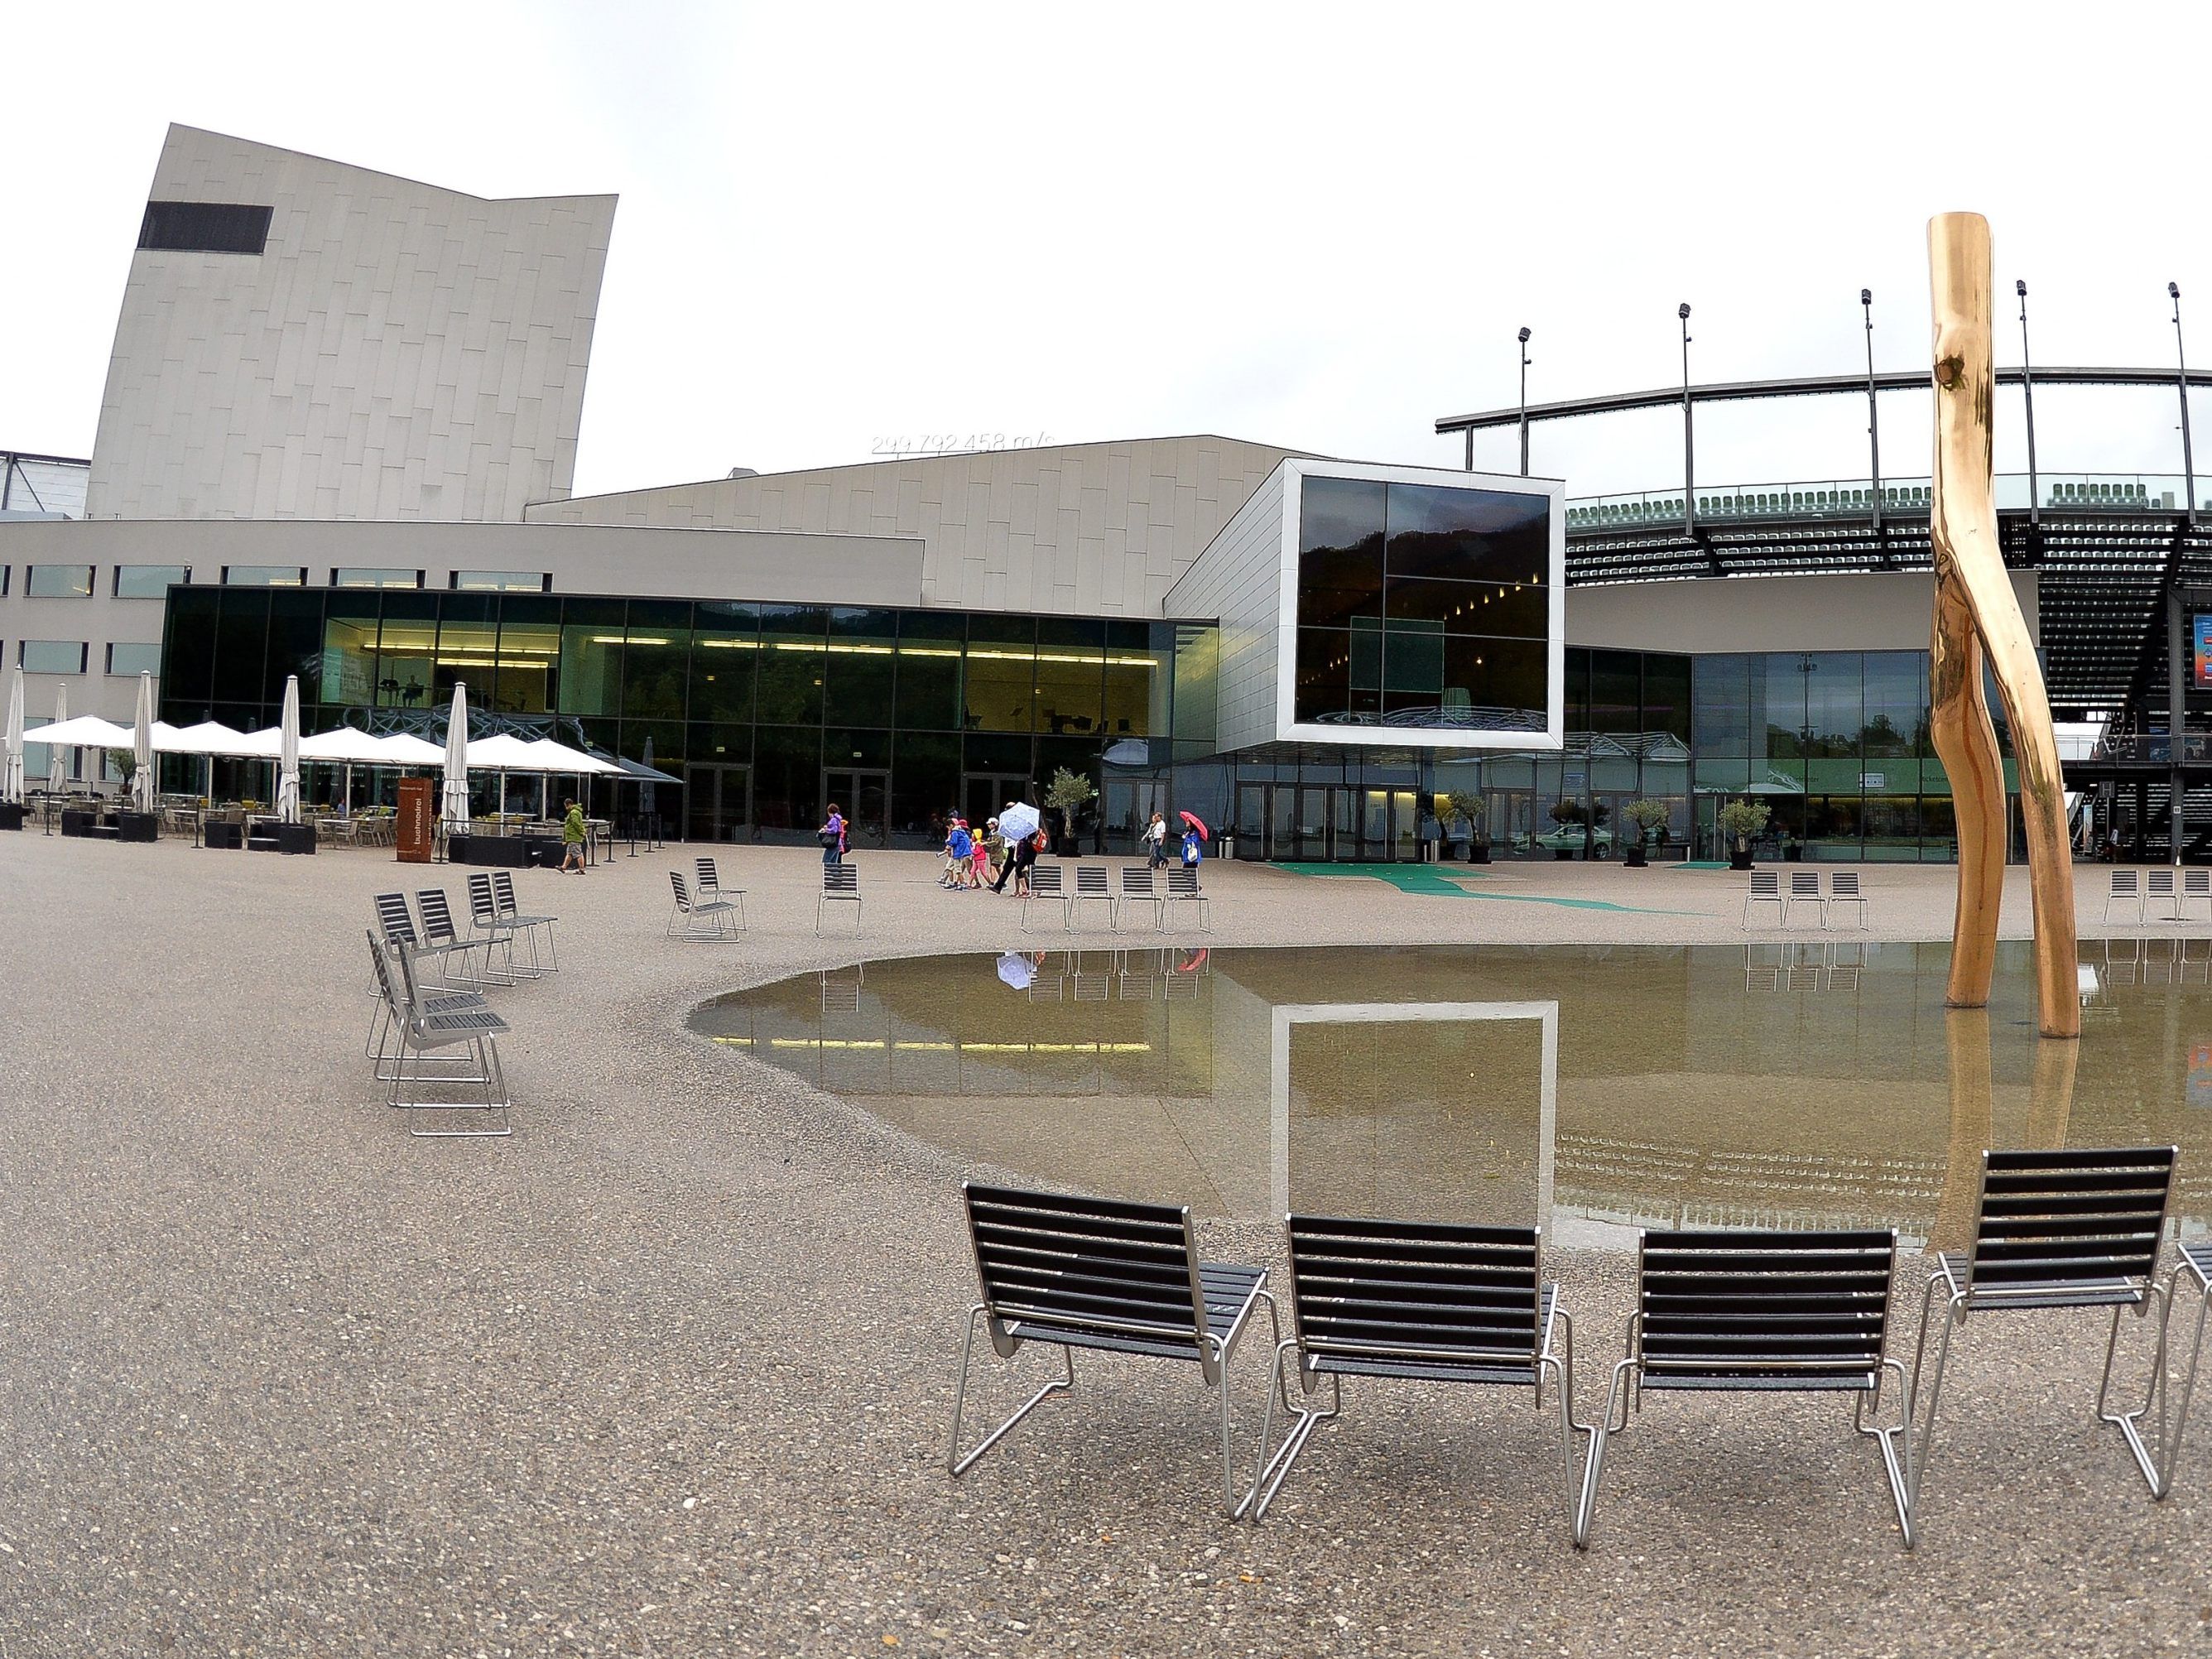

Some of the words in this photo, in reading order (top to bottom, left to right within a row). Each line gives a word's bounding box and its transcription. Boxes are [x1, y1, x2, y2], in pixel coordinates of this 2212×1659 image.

[872, 436, 911, 453] 299
[921, 434, 957, 452] 792
[964, 432, 1004, 451] 458
